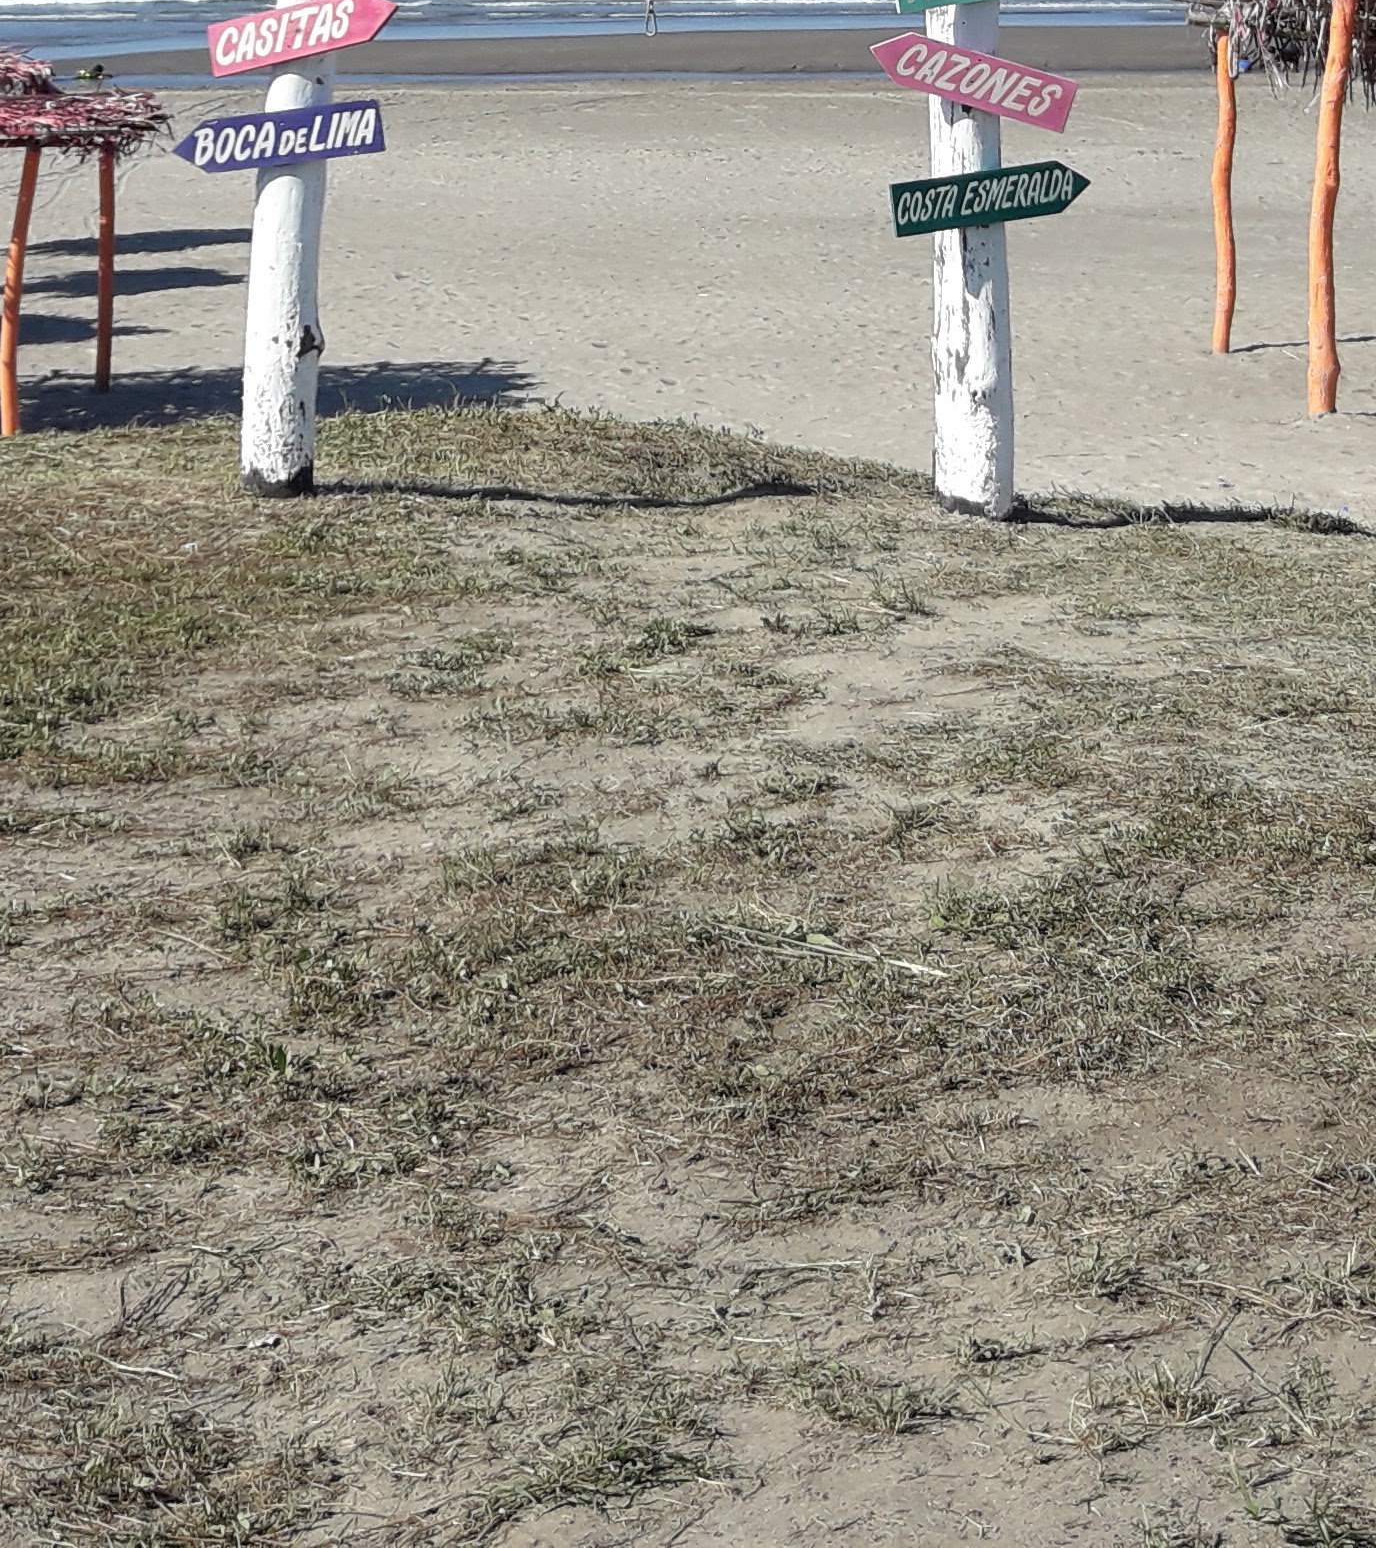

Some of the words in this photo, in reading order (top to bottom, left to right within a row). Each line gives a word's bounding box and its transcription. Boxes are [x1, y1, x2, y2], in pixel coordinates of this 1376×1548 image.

[215, 0, 355, 66] CASITAS
[896, 43, 1063, 117] CAZONES
[194, 121, 275, 166] BOCA
[309, 108, 376, 152] LIMA
[897, 183, 958, 226] COSTA
[960, 169, 1073, 216] ESMERALDA
